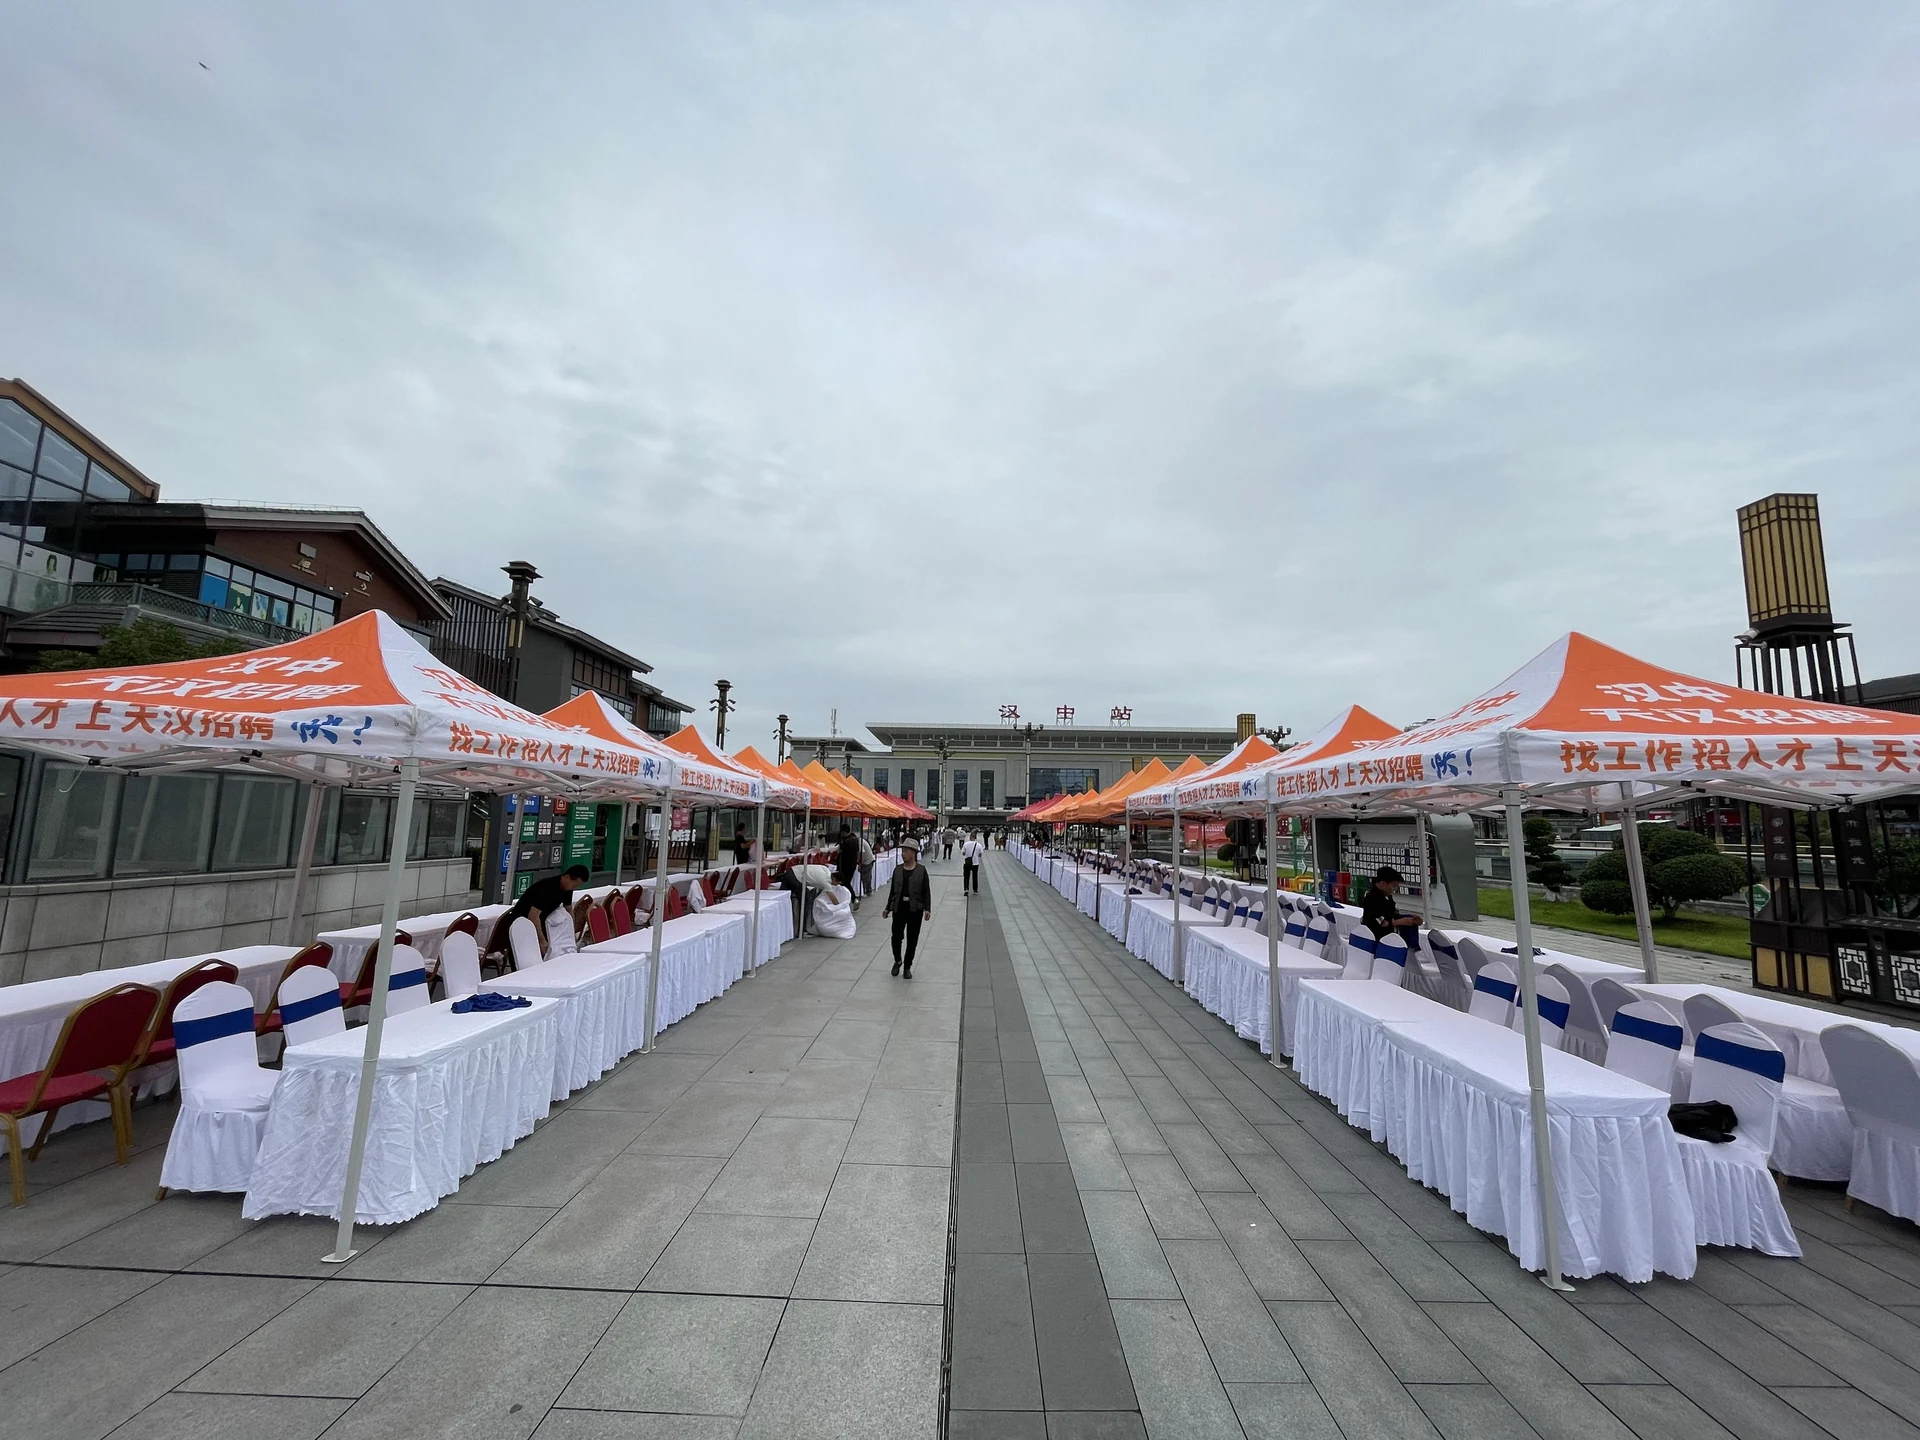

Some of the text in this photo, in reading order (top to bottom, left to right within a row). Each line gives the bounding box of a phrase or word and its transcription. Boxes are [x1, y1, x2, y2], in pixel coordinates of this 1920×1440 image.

[206, 656, 344, 677] 汉中
[1595, 681, 1732, 703] 汉中
[998, 704, 1133, 721] 汉中站
[1559, 737, 1920, 774] 找工作招人才上天
